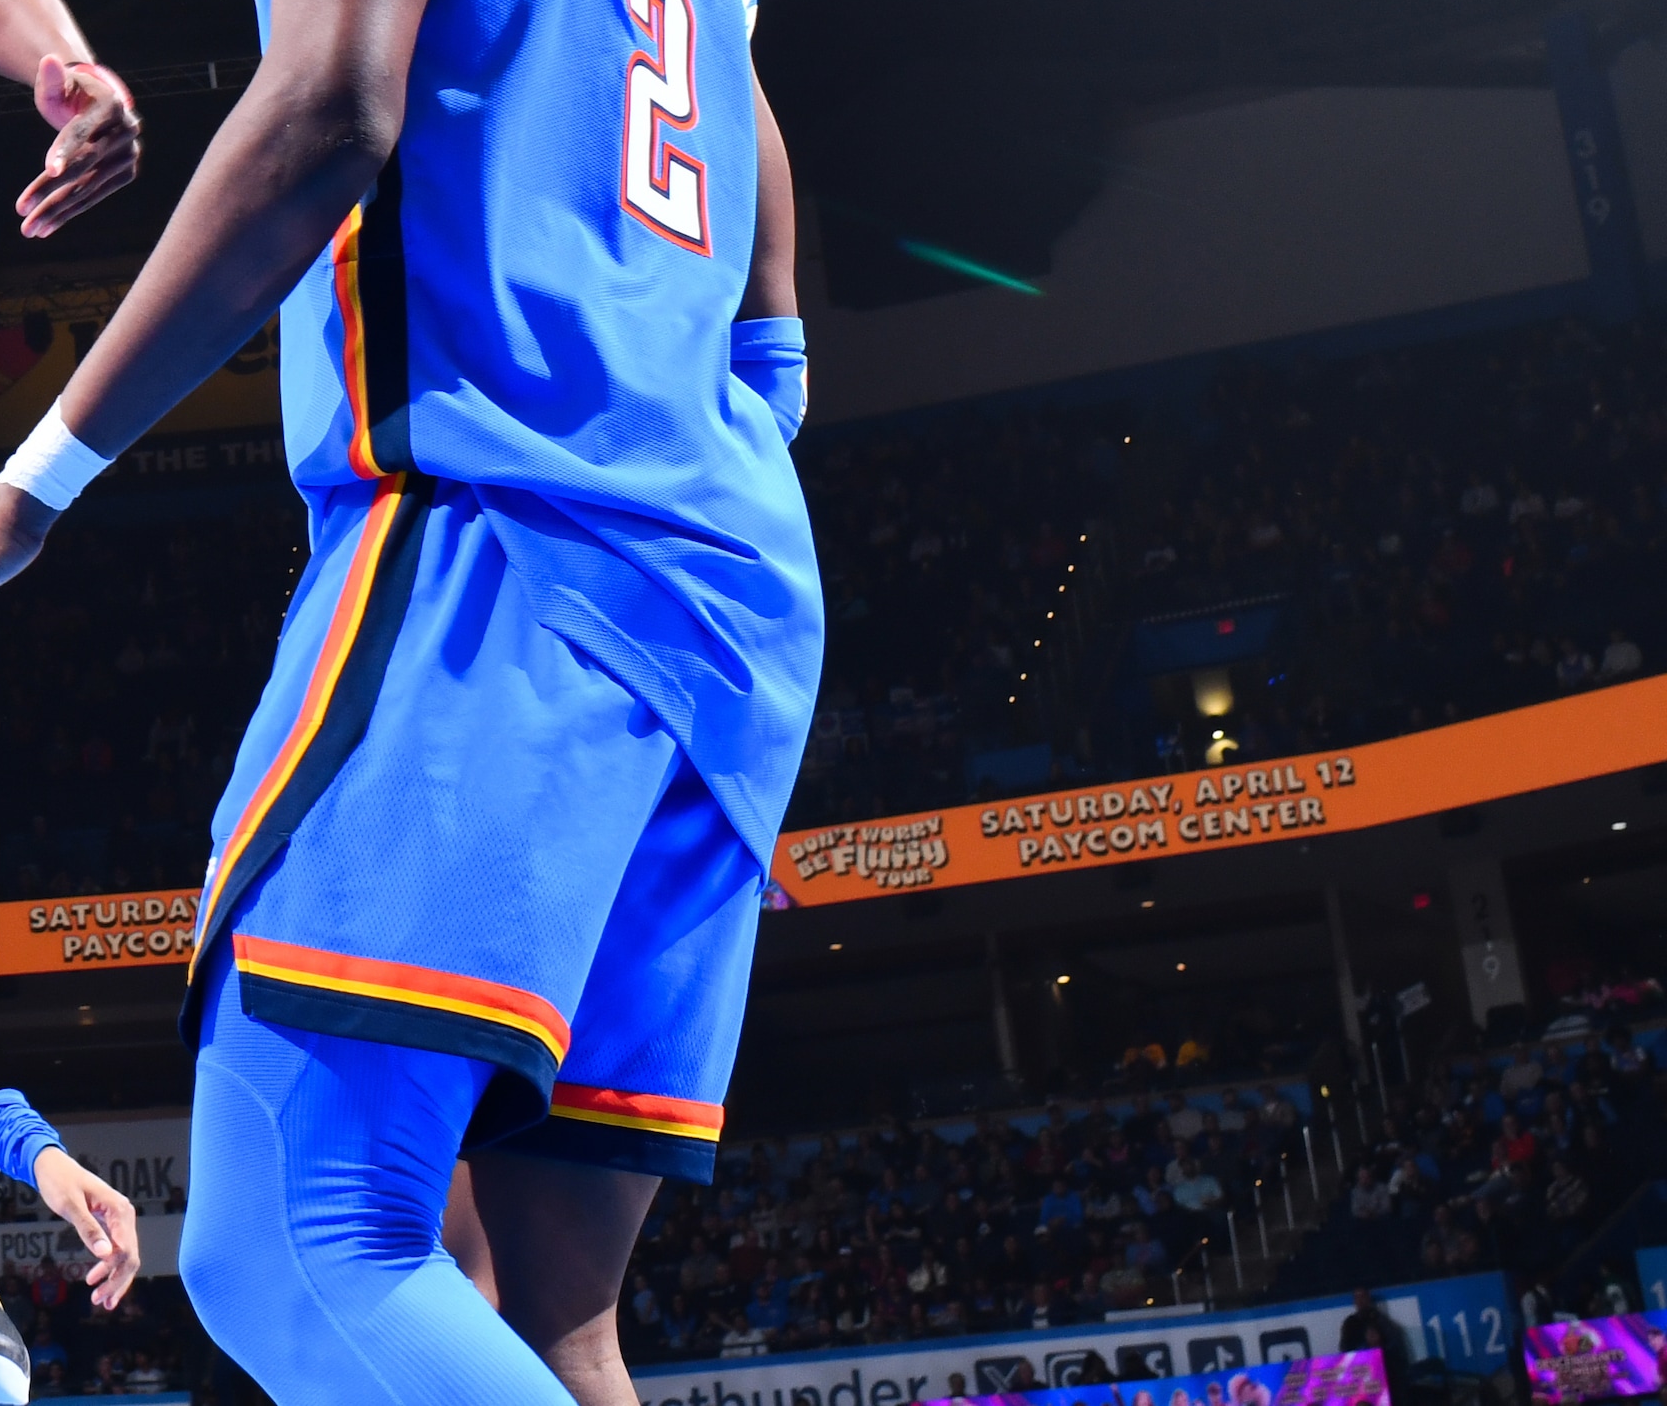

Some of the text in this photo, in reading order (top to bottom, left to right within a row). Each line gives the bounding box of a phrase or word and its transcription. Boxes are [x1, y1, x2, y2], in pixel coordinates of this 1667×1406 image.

[980, 756, 1356, 836] SATURDAY, APRIL 12
[787, 816, 943, 862] DON'T WORRY
[1018, 797, 1326, 866] PAYCOM CENTER
[796, 836, 948, 881] BE Fluffy
[875, 865, 932, 889] TOUR
[109, 1158, 175, 1195] OAK
[1, 1232, 40, 1260] POST
[1426, 1304, 1506, 1361] 112
